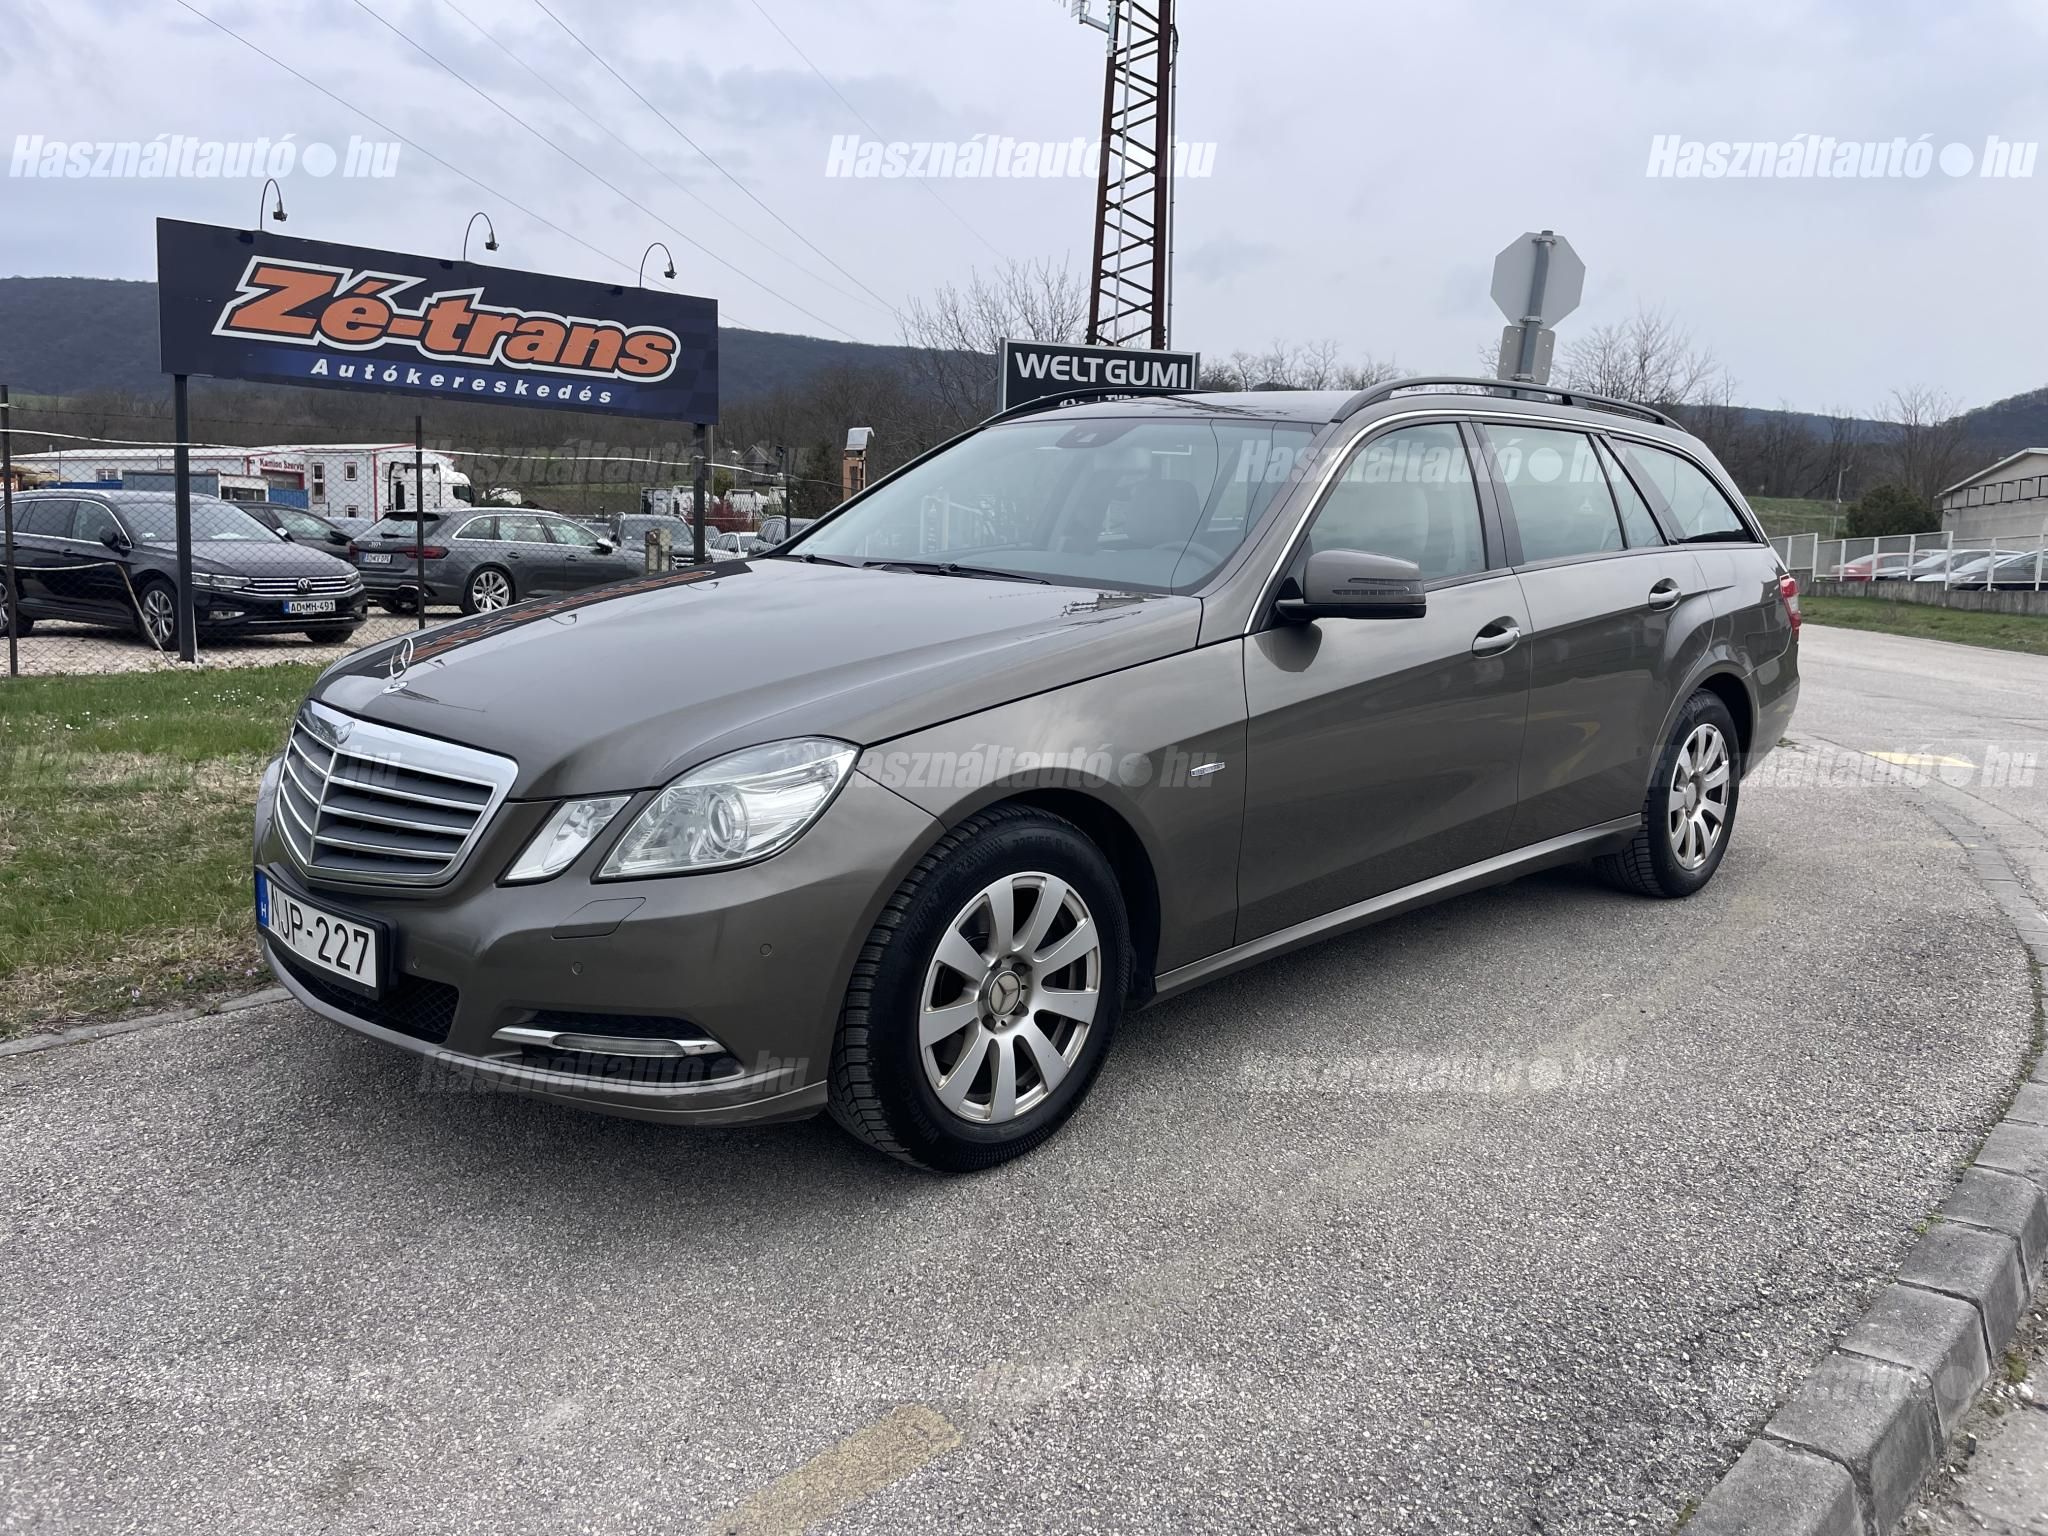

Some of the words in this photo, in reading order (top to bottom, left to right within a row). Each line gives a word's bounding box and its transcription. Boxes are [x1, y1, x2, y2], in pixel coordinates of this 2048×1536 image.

[219, 260, 678, 379] Zé-trans
[310, 358, 613, 405] Autókereskedés
[270, 883, 370, 975] NJP-227
